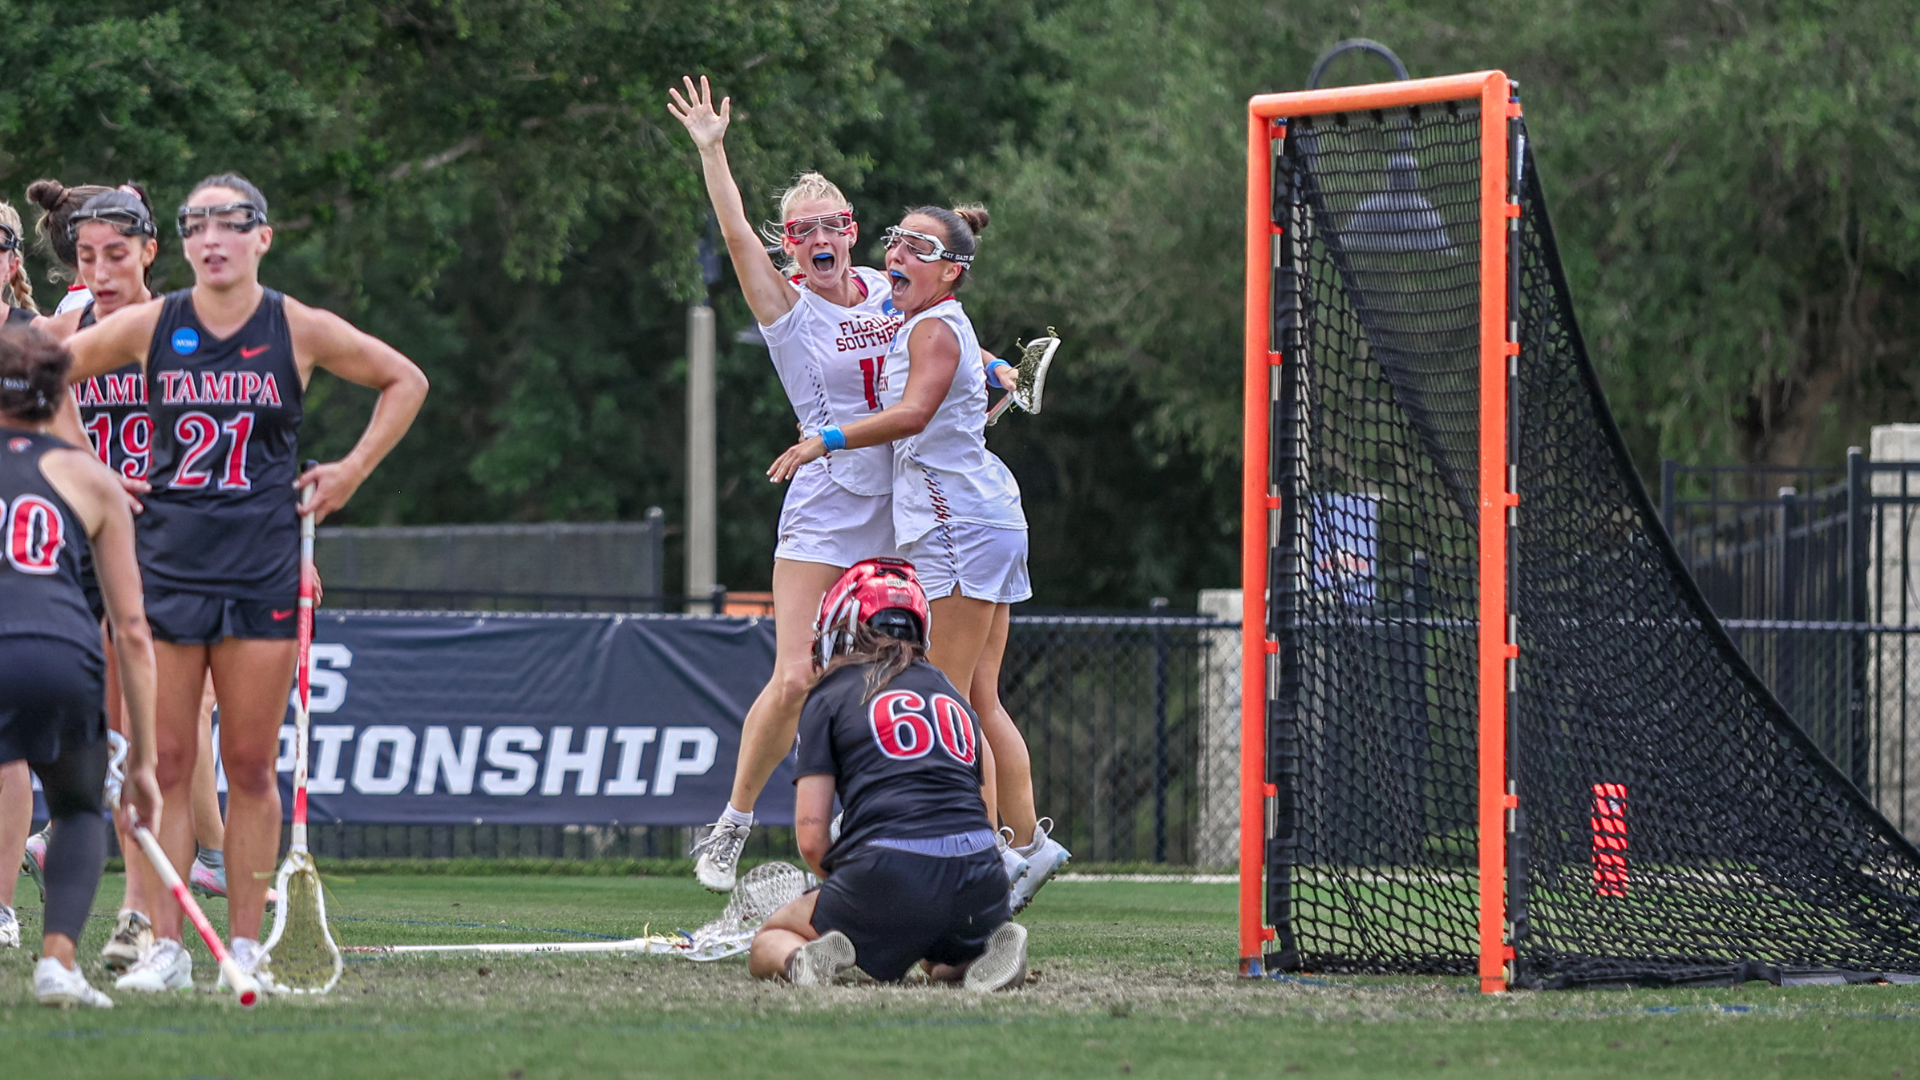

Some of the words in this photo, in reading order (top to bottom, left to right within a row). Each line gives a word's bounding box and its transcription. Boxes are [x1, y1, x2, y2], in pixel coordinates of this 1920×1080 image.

[836, 321, 903, 352] SOUTHE
[158, 369, 283, 408] TAMPA
[859, 355, 886, 410] 1
[85, 411, 154, 480] 19
[168, 411, 256, 491] 21
[0, 493, 66, 575] 0
[275, 724, 718, 795] PIONSHIP
[869, 690, 976, 766] 60
